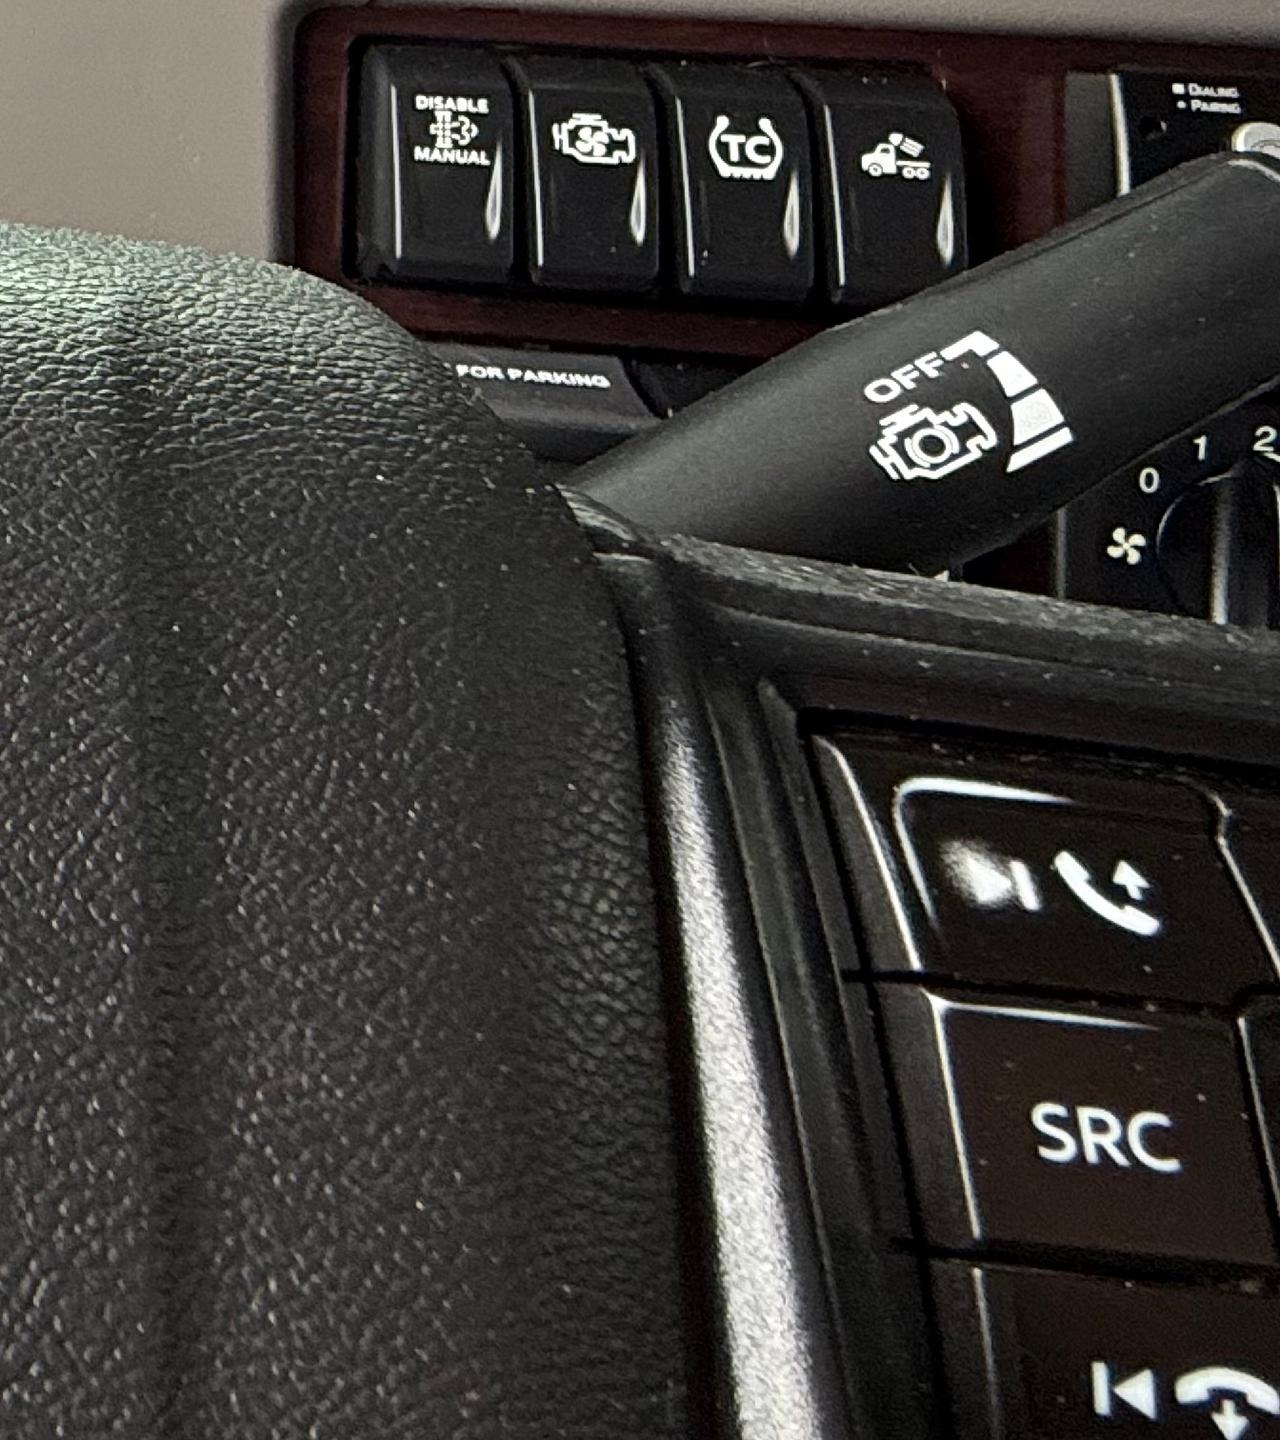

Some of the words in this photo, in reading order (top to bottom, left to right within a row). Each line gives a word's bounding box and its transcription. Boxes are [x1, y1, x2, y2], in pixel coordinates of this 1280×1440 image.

[414, 94, 490, 114] DISABLE
[413, 145, 491, 167] MANUAL
[720, 133, 773, 165] TC
[455, 364, 506, 381] FOR
[507, 367, 612, 389] PARKING
[863, 350, 945, 404] OFF
[1192, 434, 1208, 462] 1
[1252, 424, 1279, 453] 2
[1138, 466, 1161, 494] 0
[1030, 1101, 1184, 1174] SRC
